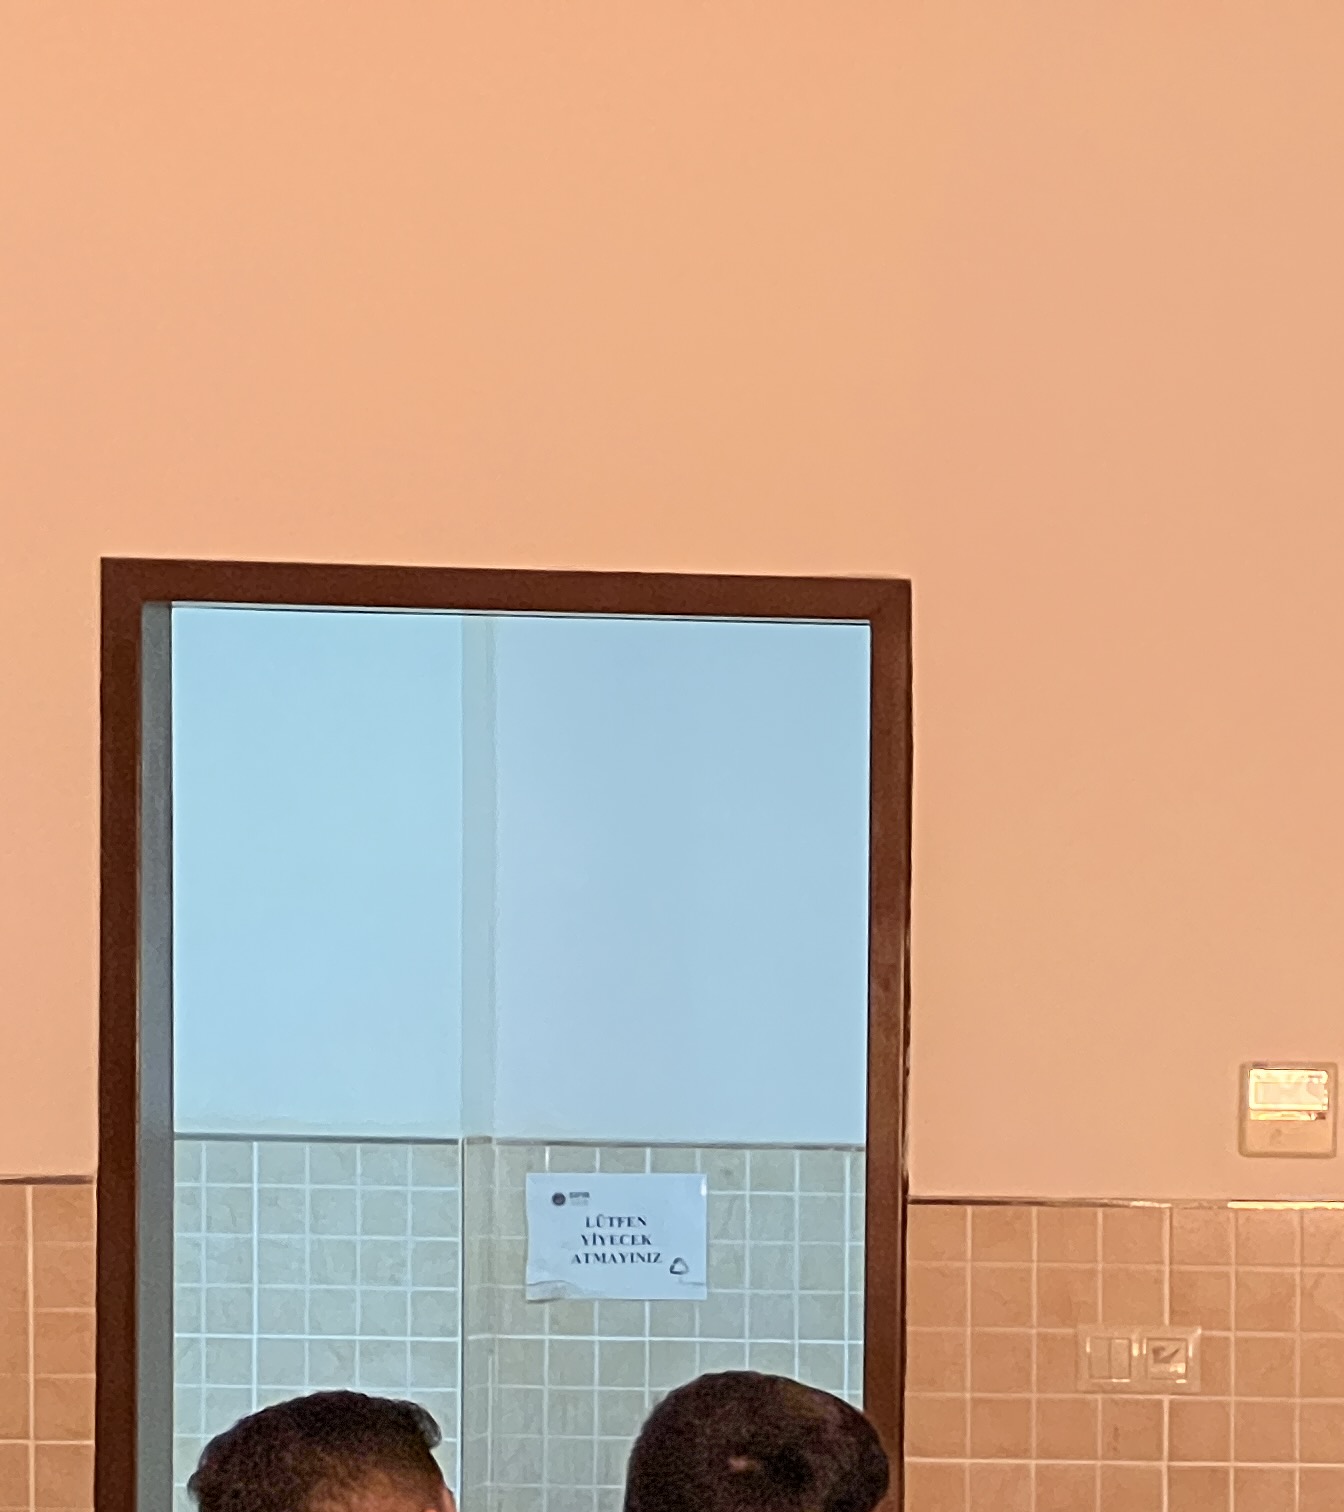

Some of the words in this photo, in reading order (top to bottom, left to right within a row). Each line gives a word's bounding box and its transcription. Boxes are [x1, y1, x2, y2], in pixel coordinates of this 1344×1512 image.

[585, 1214, 648, 1228] LÜTFEN
[581, 1232, 652, 1246] YİYECEK
[571, 1252, 663, 1265] ATMAYINIZ
